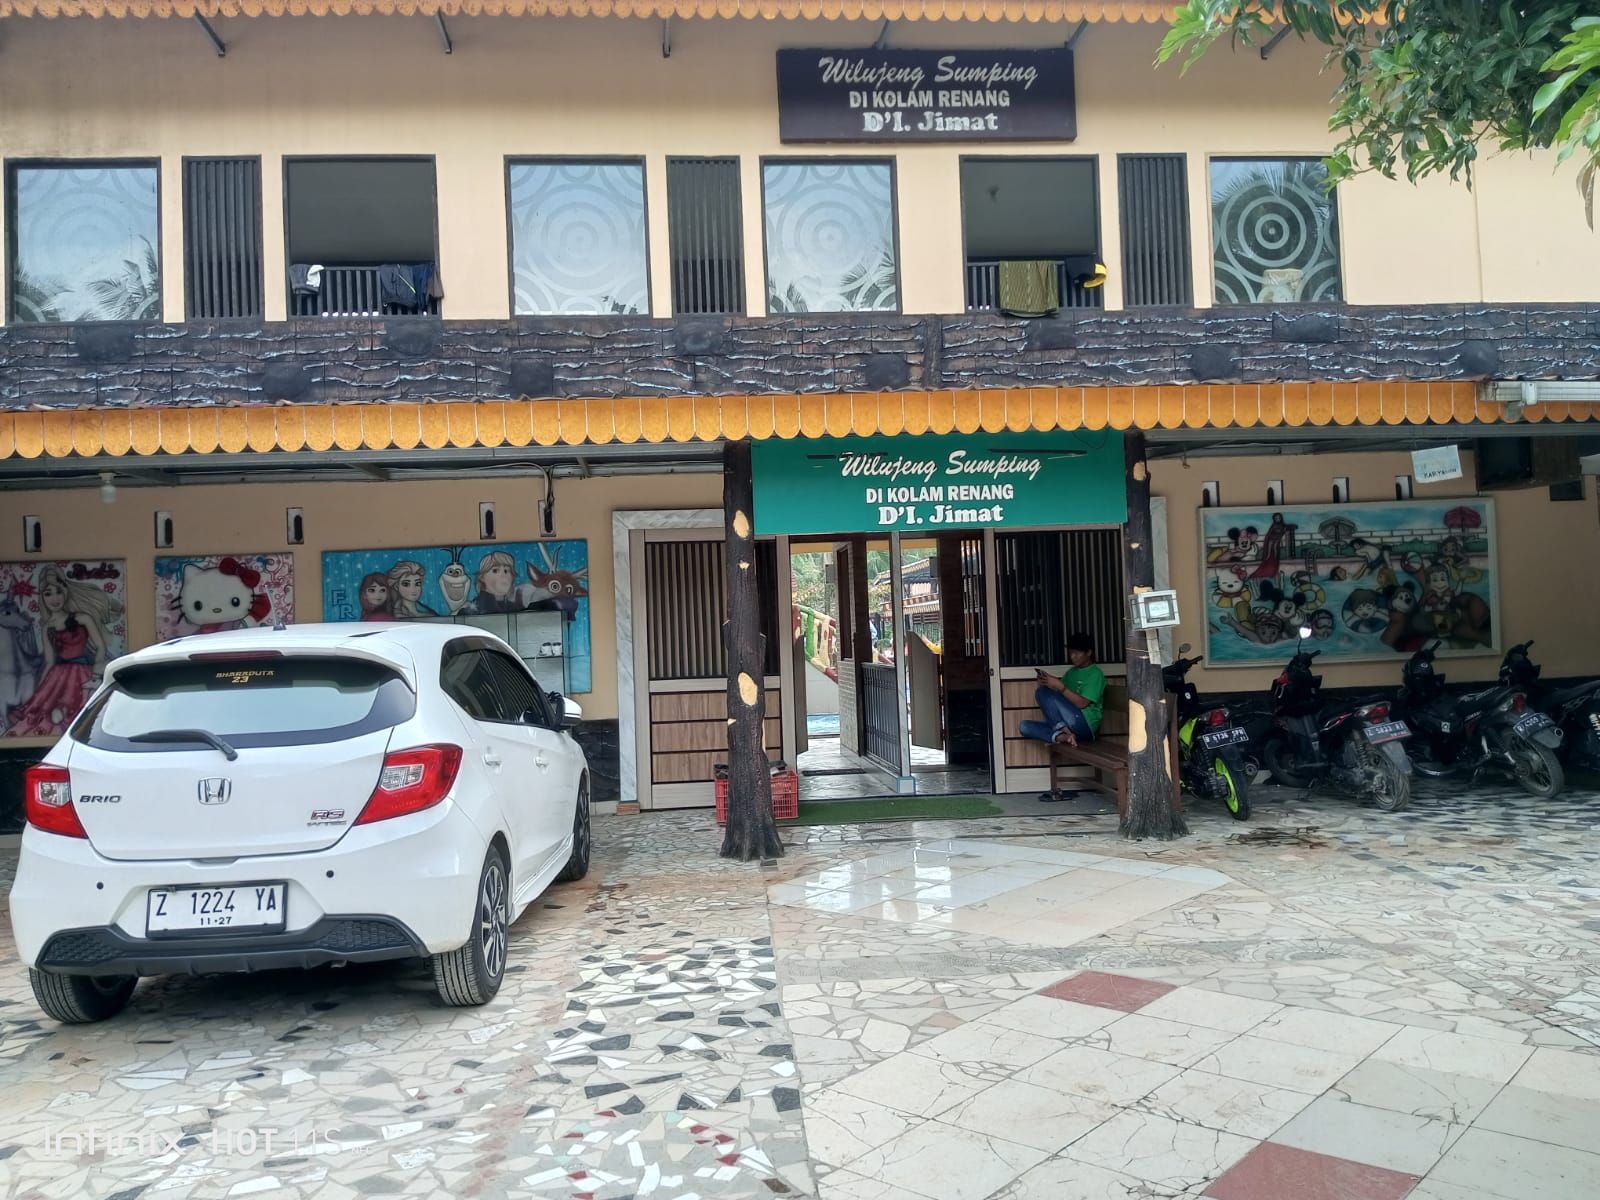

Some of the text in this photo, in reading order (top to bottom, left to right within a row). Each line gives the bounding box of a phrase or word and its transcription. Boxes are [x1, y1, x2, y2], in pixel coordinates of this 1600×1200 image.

[818, 56, 1038, 90] Wilujeng Sumping
[849, 90, 1010, 108] DI KOLAM RENANG
[917, 110, 998, 131] Jimat
[838, 450, 1042, 482] Wilujeng Sumping
[866, 484, 1014, 504] DI KOLAM RENANG
[929, 505, 1004, 524] Jimat
[80, 795, 121, 803] BRIO
[310, 808, 345, 820] RS
[156, 887, 276, 916] Z 1224 YA
